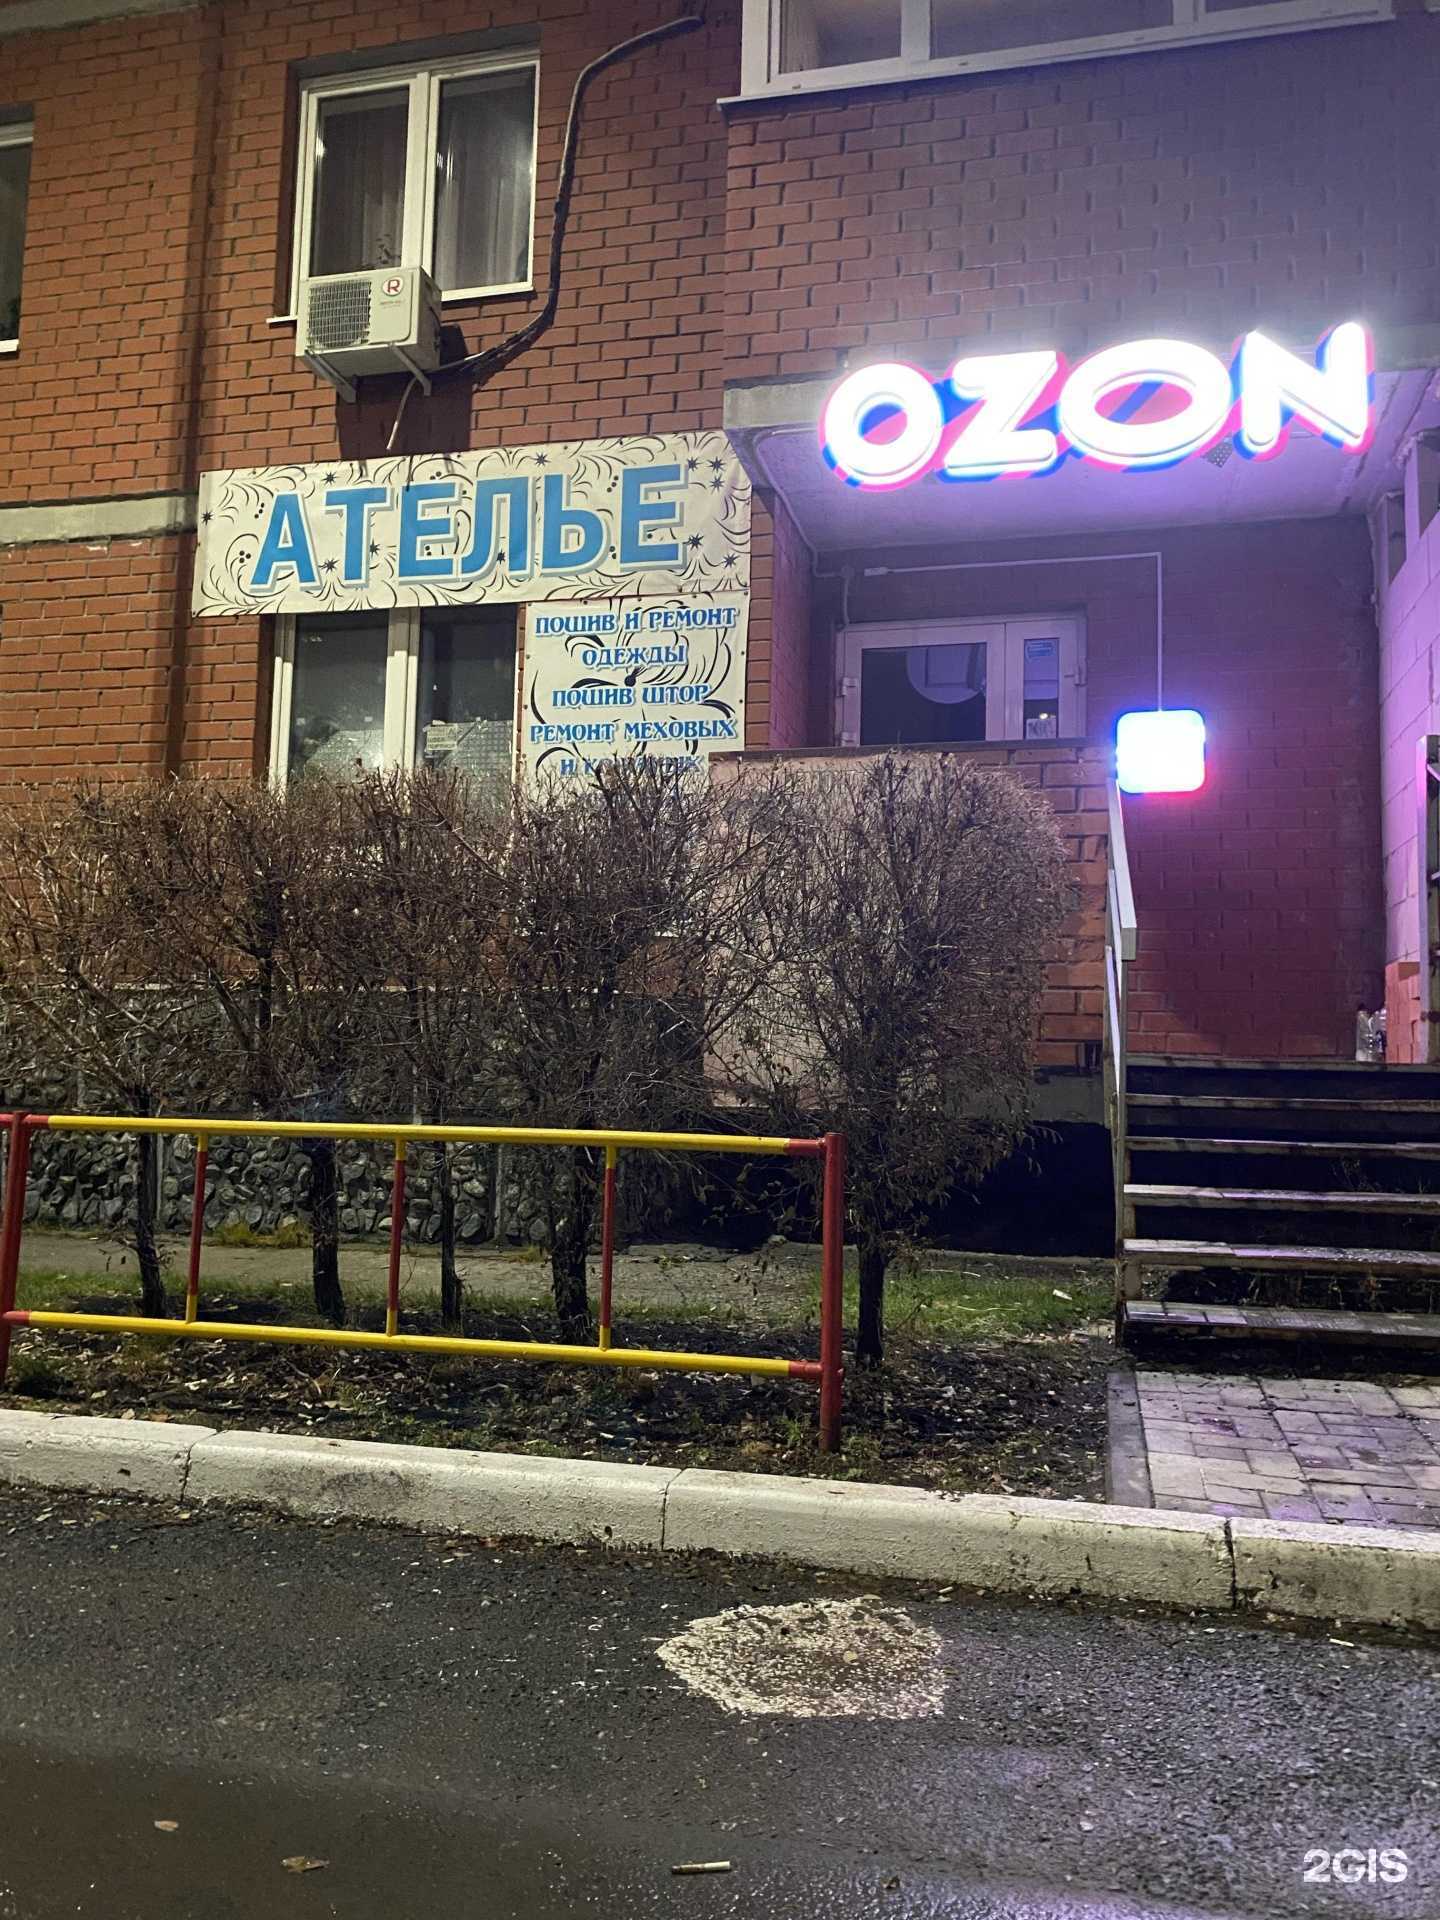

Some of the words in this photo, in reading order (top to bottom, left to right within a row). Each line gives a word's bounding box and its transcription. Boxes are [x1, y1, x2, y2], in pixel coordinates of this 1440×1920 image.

[822, 321, 1371, 488] OZON
[250, 463, 686, 590] АТЕЛЬЕ
[536, 614, 616, 633] ПОШИВ
[625, 611, 640, 630] И
[649, 607, 737, 629] РЕМОНТ
[582, 644, 687, 668] ОДЕЖДЫ
[552, 687, 634, 707] ПОШИВ
[642, 684, 710, 704] ШТОР
[530, 723, 615, 743] РЕМОНТ
[624, 719, 736, 740] МЕХОВЫХ
[560, 758, 577, 777] И
